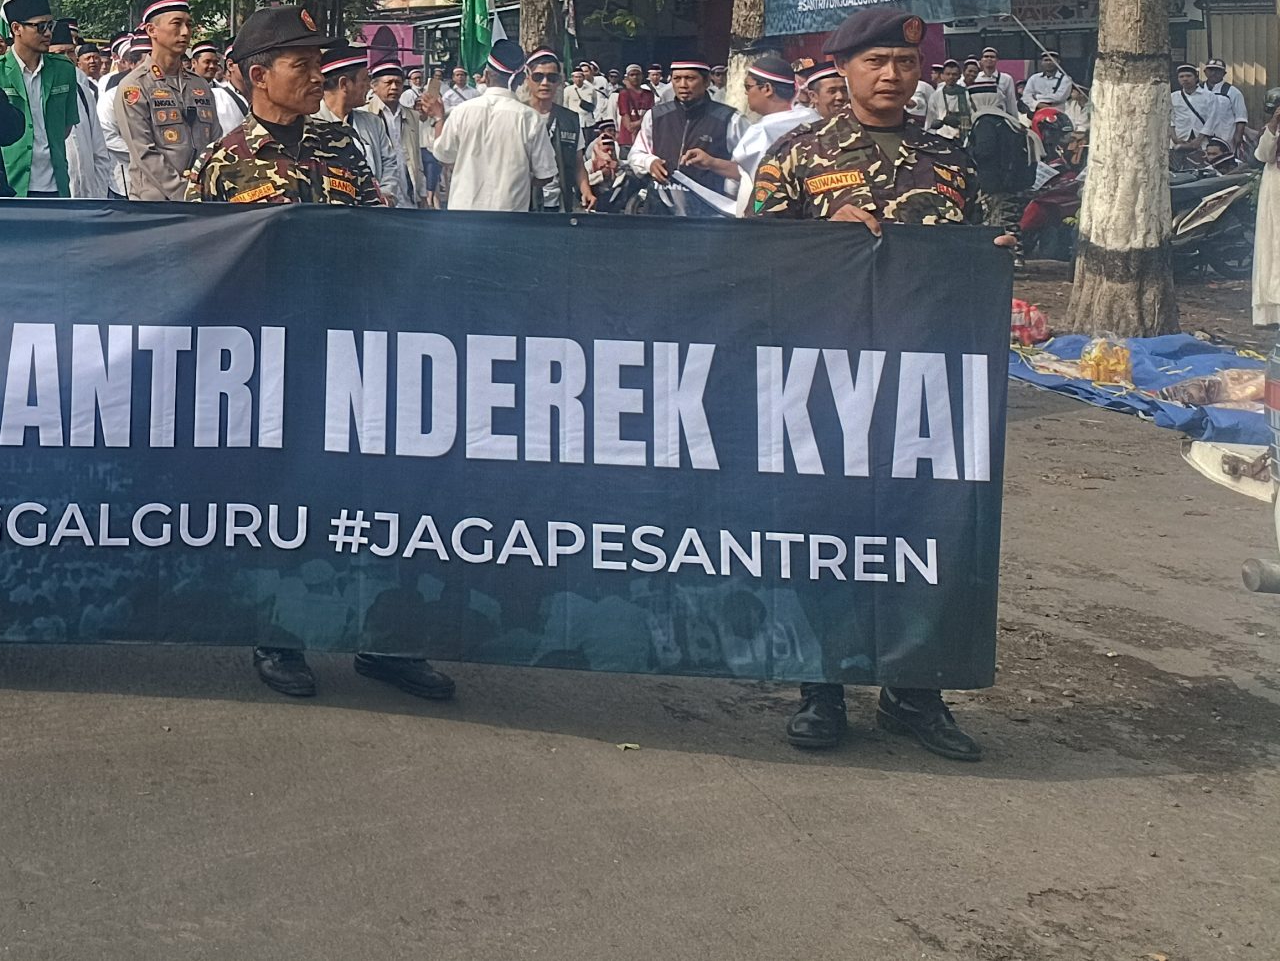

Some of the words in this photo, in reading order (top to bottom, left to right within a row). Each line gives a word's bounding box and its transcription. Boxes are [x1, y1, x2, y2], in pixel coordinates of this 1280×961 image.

[809, 173, 858, 192] SUWANTO
[324, 329, 720, 471] NDEREK
[756, 345, 991, 482] KYAI
[328, 509, 939, 585] #JAGAPESANTREN
